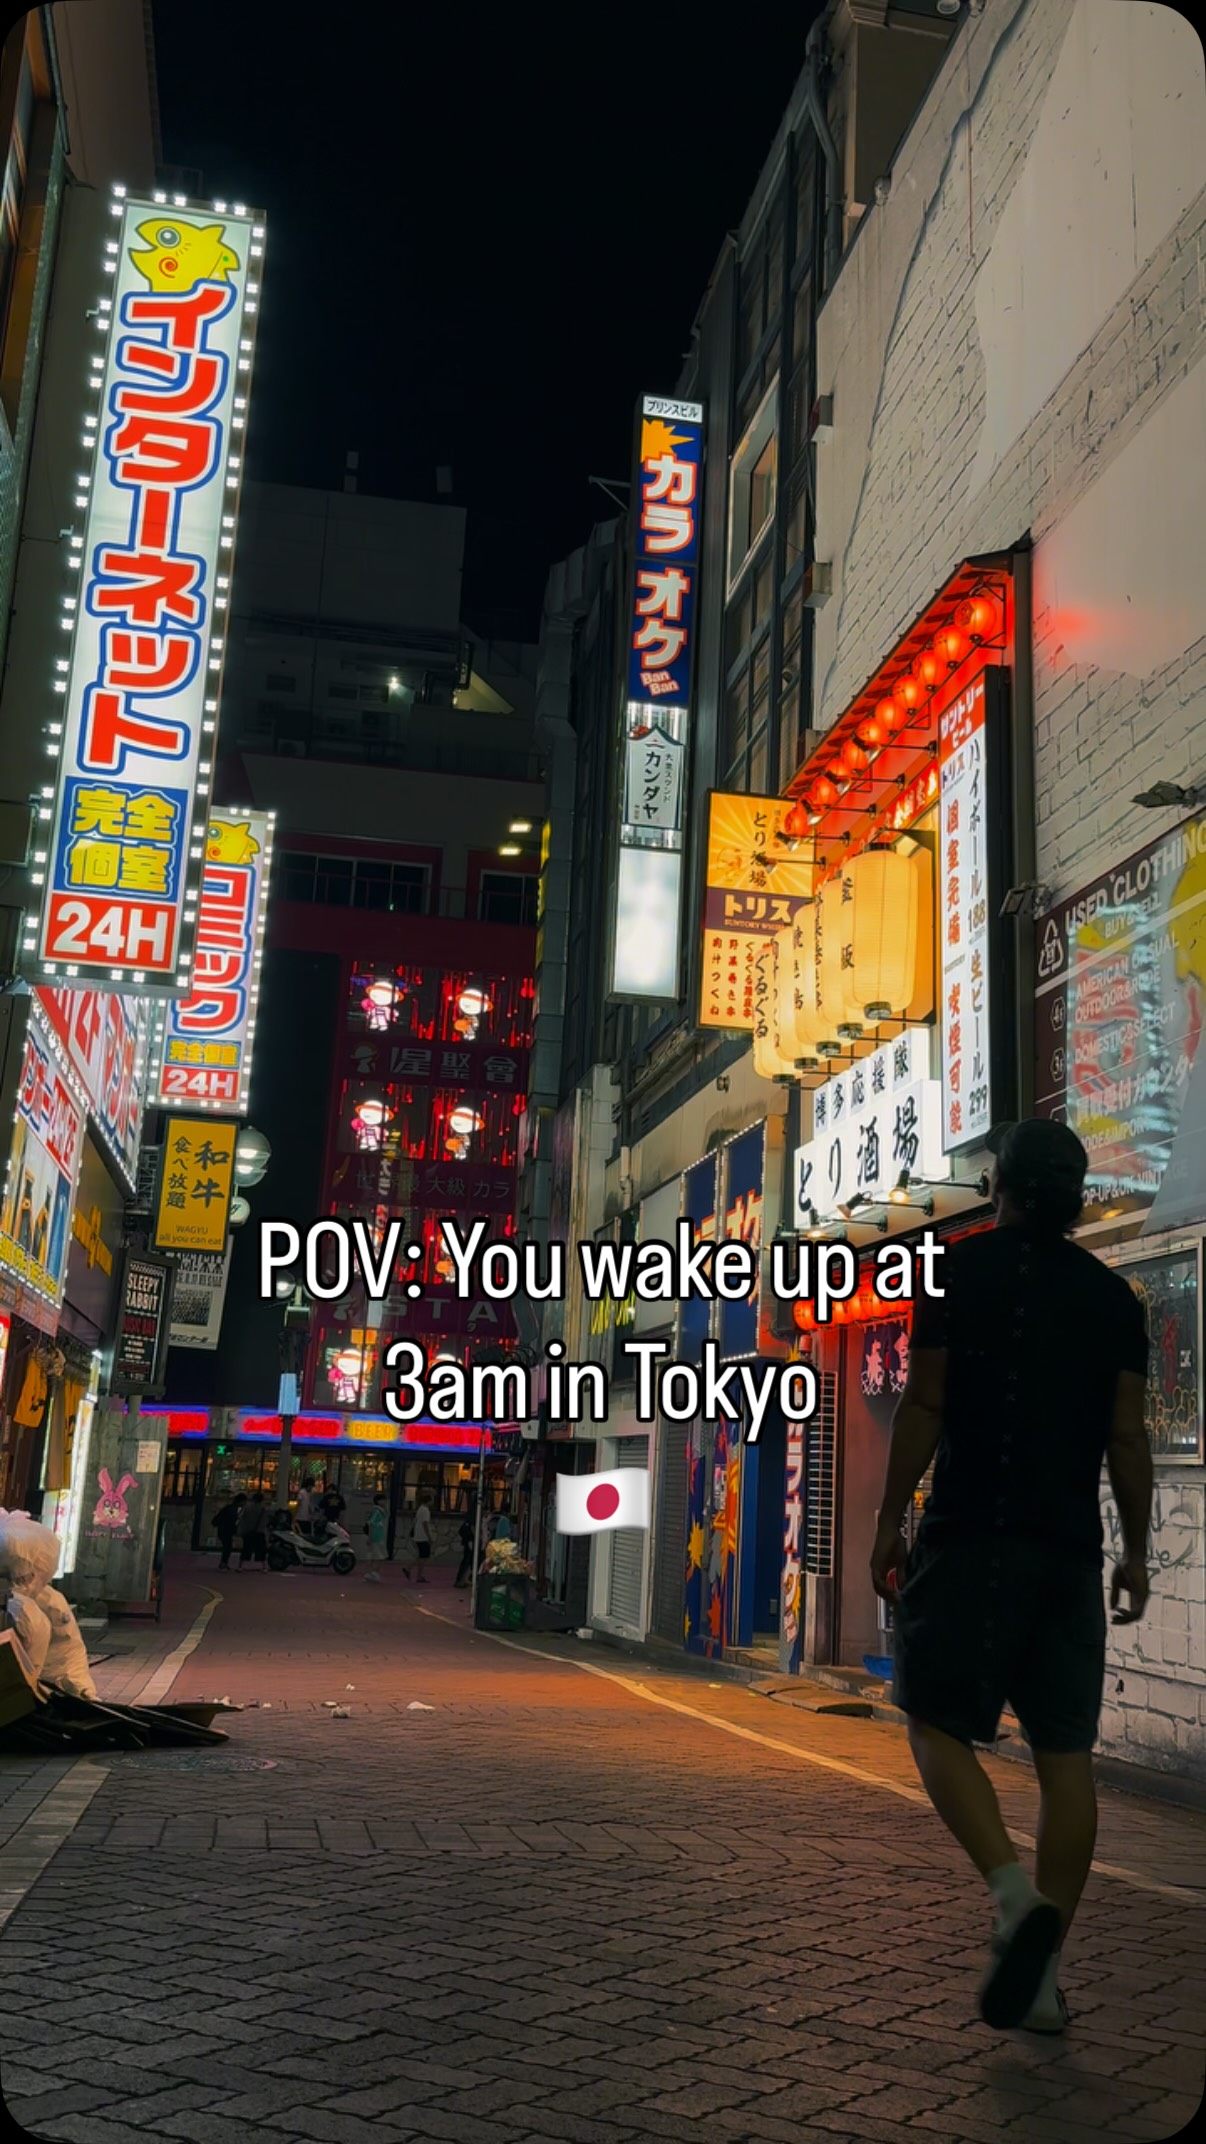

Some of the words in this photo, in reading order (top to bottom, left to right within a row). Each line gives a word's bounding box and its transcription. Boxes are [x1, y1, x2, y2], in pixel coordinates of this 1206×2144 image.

[646, 400, 699, 419] プリンスビル
[80, 280, 235, 773] インターネット
[635, 453, 696, 668] カラオケ
[640, 671, 670, 686] Ban
[649, 681, 679, 696] Ban
[642, 751, 661, 820] カンダヤ
[72, 786, 177, 843] 完全
[68, 839, 169, 894] 個室
[724, 894, 792, 923] トリス
[967, 898, 986, 933] 188
[1064, 888, 1108, 937] USED
[53, 901, 169, 963] 24H
[755, 953, 770, 1039] ぐるぐる
[1075, 956, 1129, 1000] AMERICAN
[971, 949, 983, 1082] 生ビール
[166, 1069, 233, 1097] 24H
[968, 1084, 988, 1117] 299
[166, 1136, 191, 1210] 食べ放題
[190, 1140, 231, 1209] 和牛
[798, 1095, 920, 1212] とり酒場
[172, 1235, 189, 1244] you
[190, 1236, 207, 1244] can
[208, 1238, 222, 1246] eat
[174, 1225, 209, 1235] WAGYU
[128, 1273, 160, 1294] SLEEPY
[354, 1422, 393, 1440] BEER
